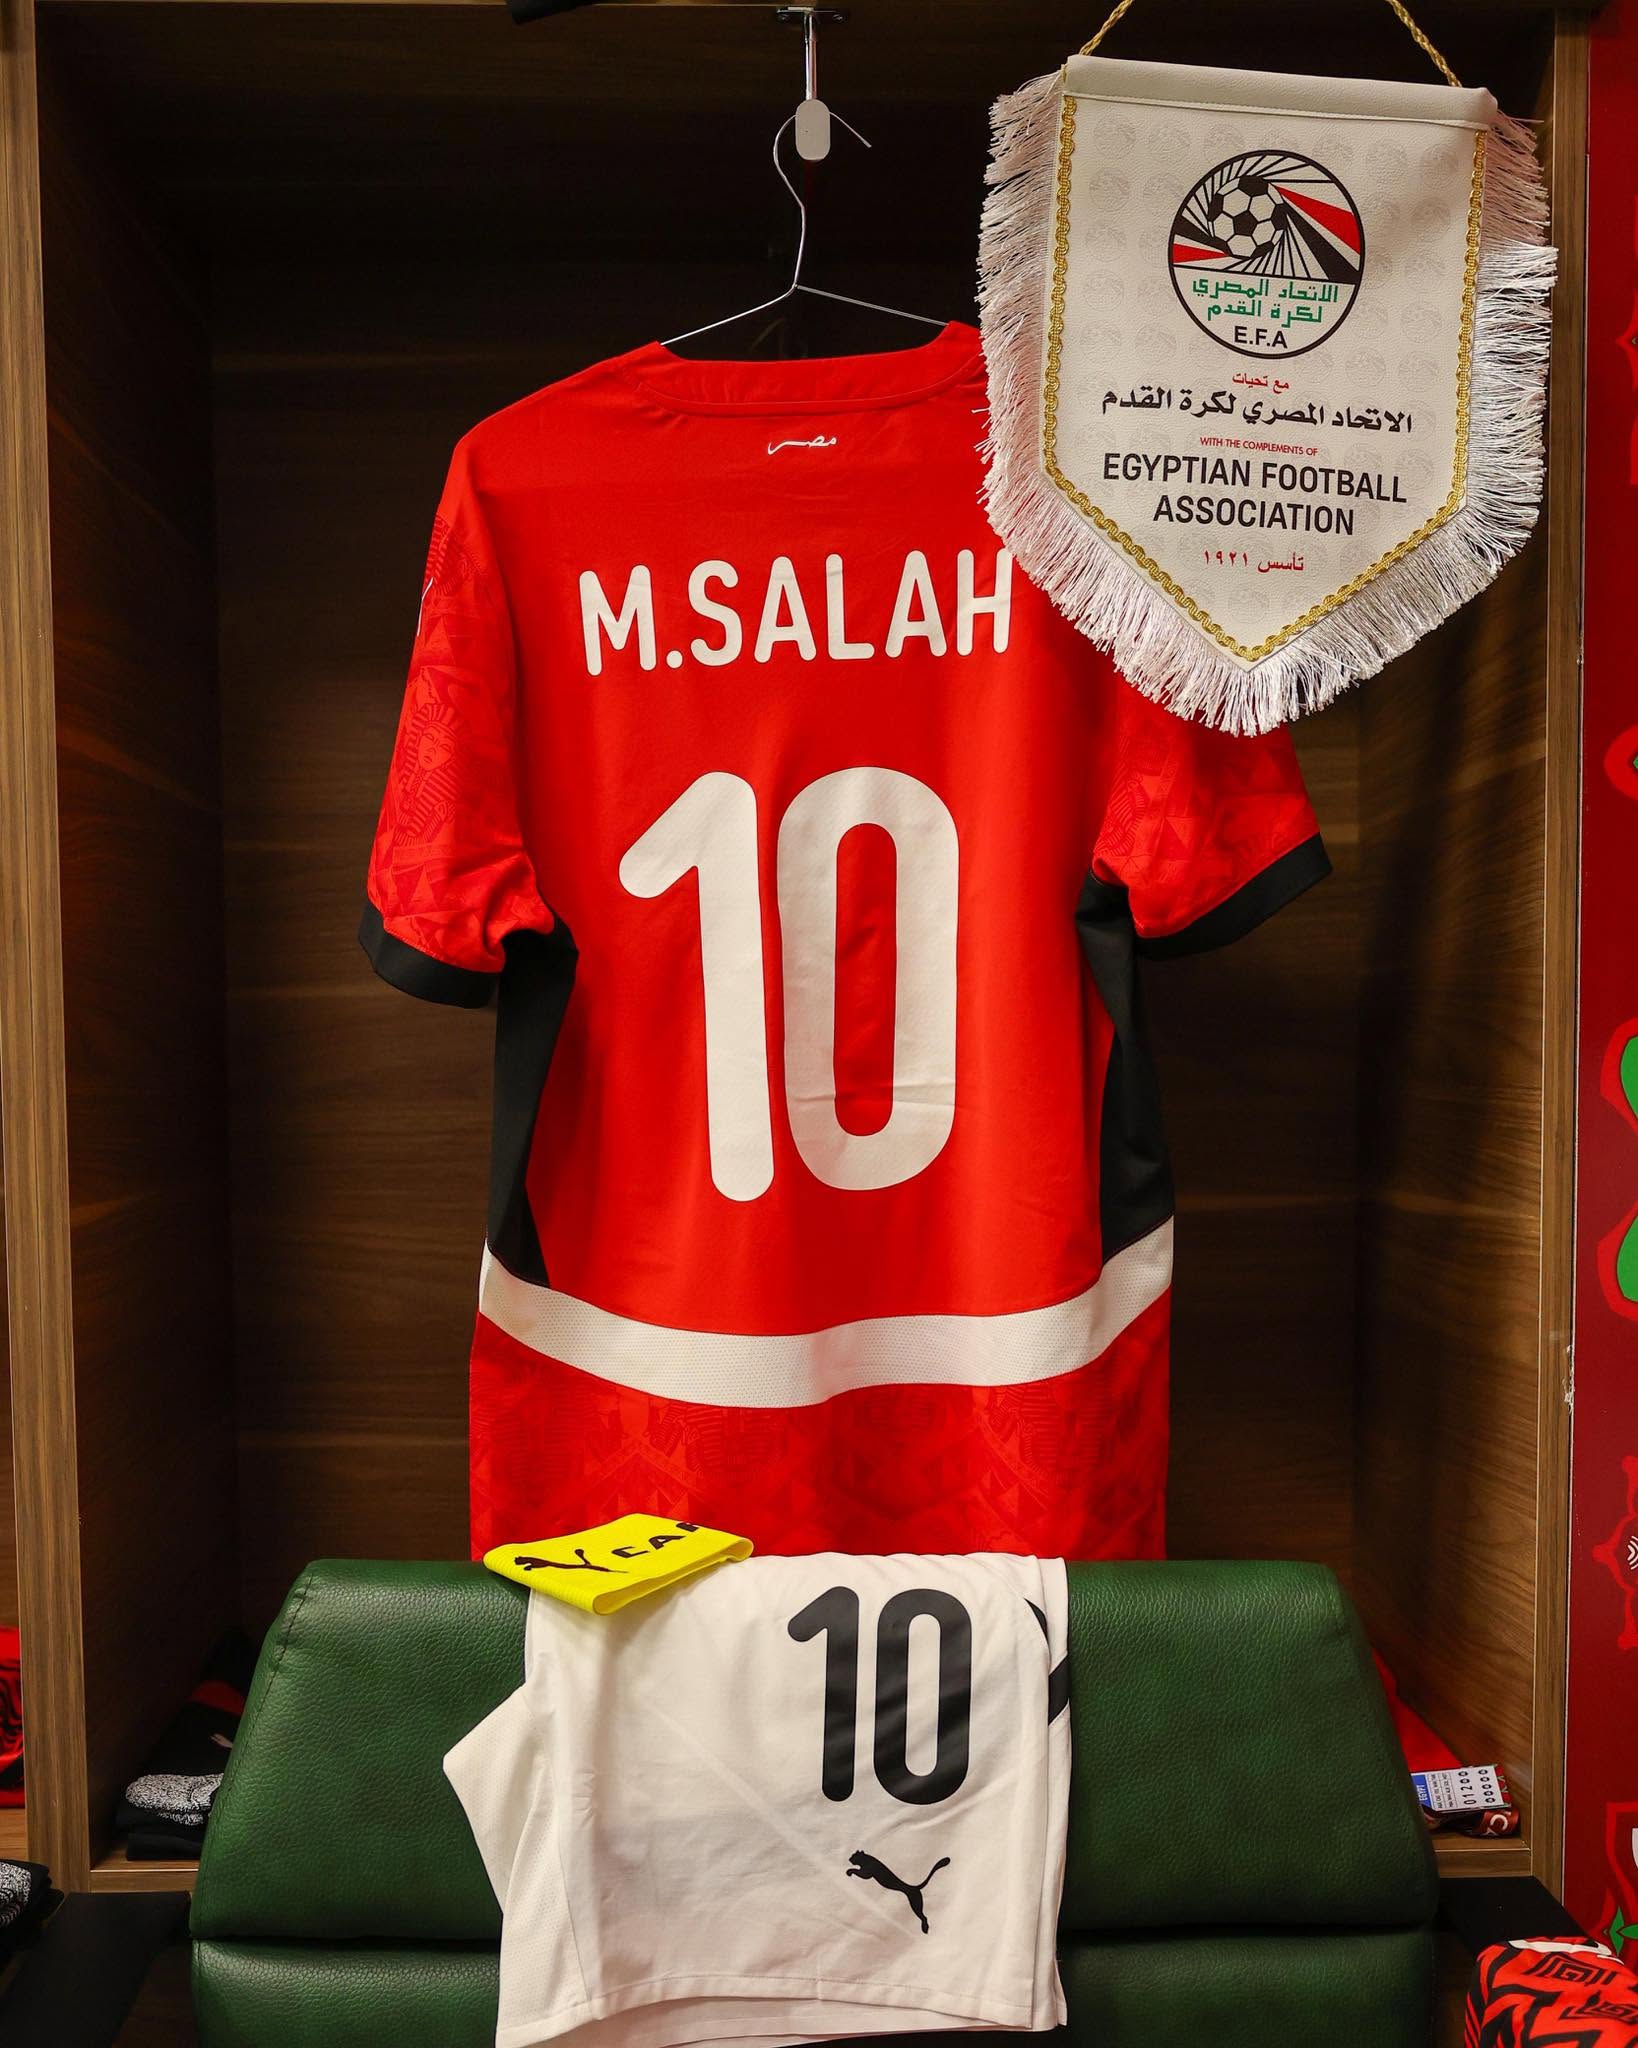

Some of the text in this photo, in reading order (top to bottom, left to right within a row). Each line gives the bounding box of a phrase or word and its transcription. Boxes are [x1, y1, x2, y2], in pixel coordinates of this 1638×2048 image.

[1193, 278, 1338, 303] الاتحاد المصري
[1207, 299, 1322, 328] لكرة القدم
[1234, 325, 1288, 349] E.F.A
[1232, 373, 1290, 394] مع تحيات
[1102, 385, 1412, 433] الاتحاد المصري لكرة القدم
[767, 434, 838, 455] مصر
[1200, 437, 1318, 457] WITH THE COMPLEMENTS OF
[1103, 452, 1408, 503] EGYPTIAN FOOTBALL
[1152, 494, 1355, 535] ASSOCIATION
[1204, 549, 1304, 573] تأسس ١٩٢١
[579, 549, 1013, 676] M.SALAH
[619, 766, 960, 1202] 10
[787, 1586, 972, 1805] 10
[1415, 1784, 1429, 1801] EGYPT
